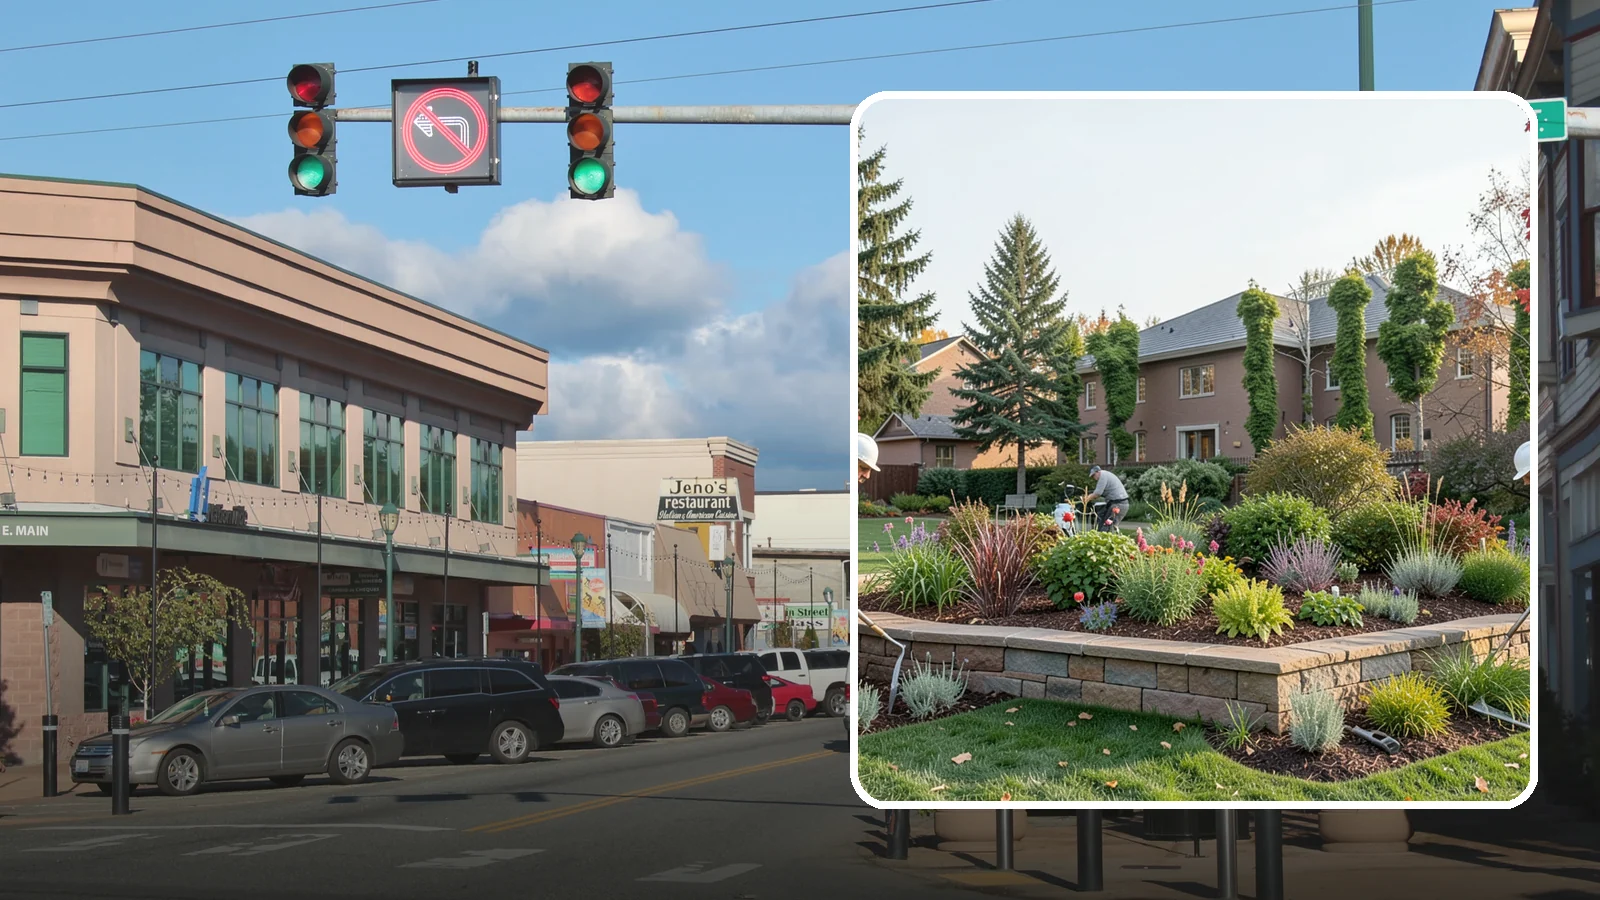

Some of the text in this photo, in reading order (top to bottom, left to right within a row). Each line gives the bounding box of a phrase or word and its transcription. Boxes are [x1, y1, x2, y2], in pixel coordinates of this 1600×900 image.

[669, 480, 727, 494] Jeno's
[665, 496, 731, 509] restaurant
[658, 510, 682, 519] Italian
[686, 510, 714, 519] American
[715, 509, 737, 519] Cuisine
[2, 525, 49, 536] E. MAIN
[797, 607, 828, 616] Street
[791, 619, 823, 627] lass
